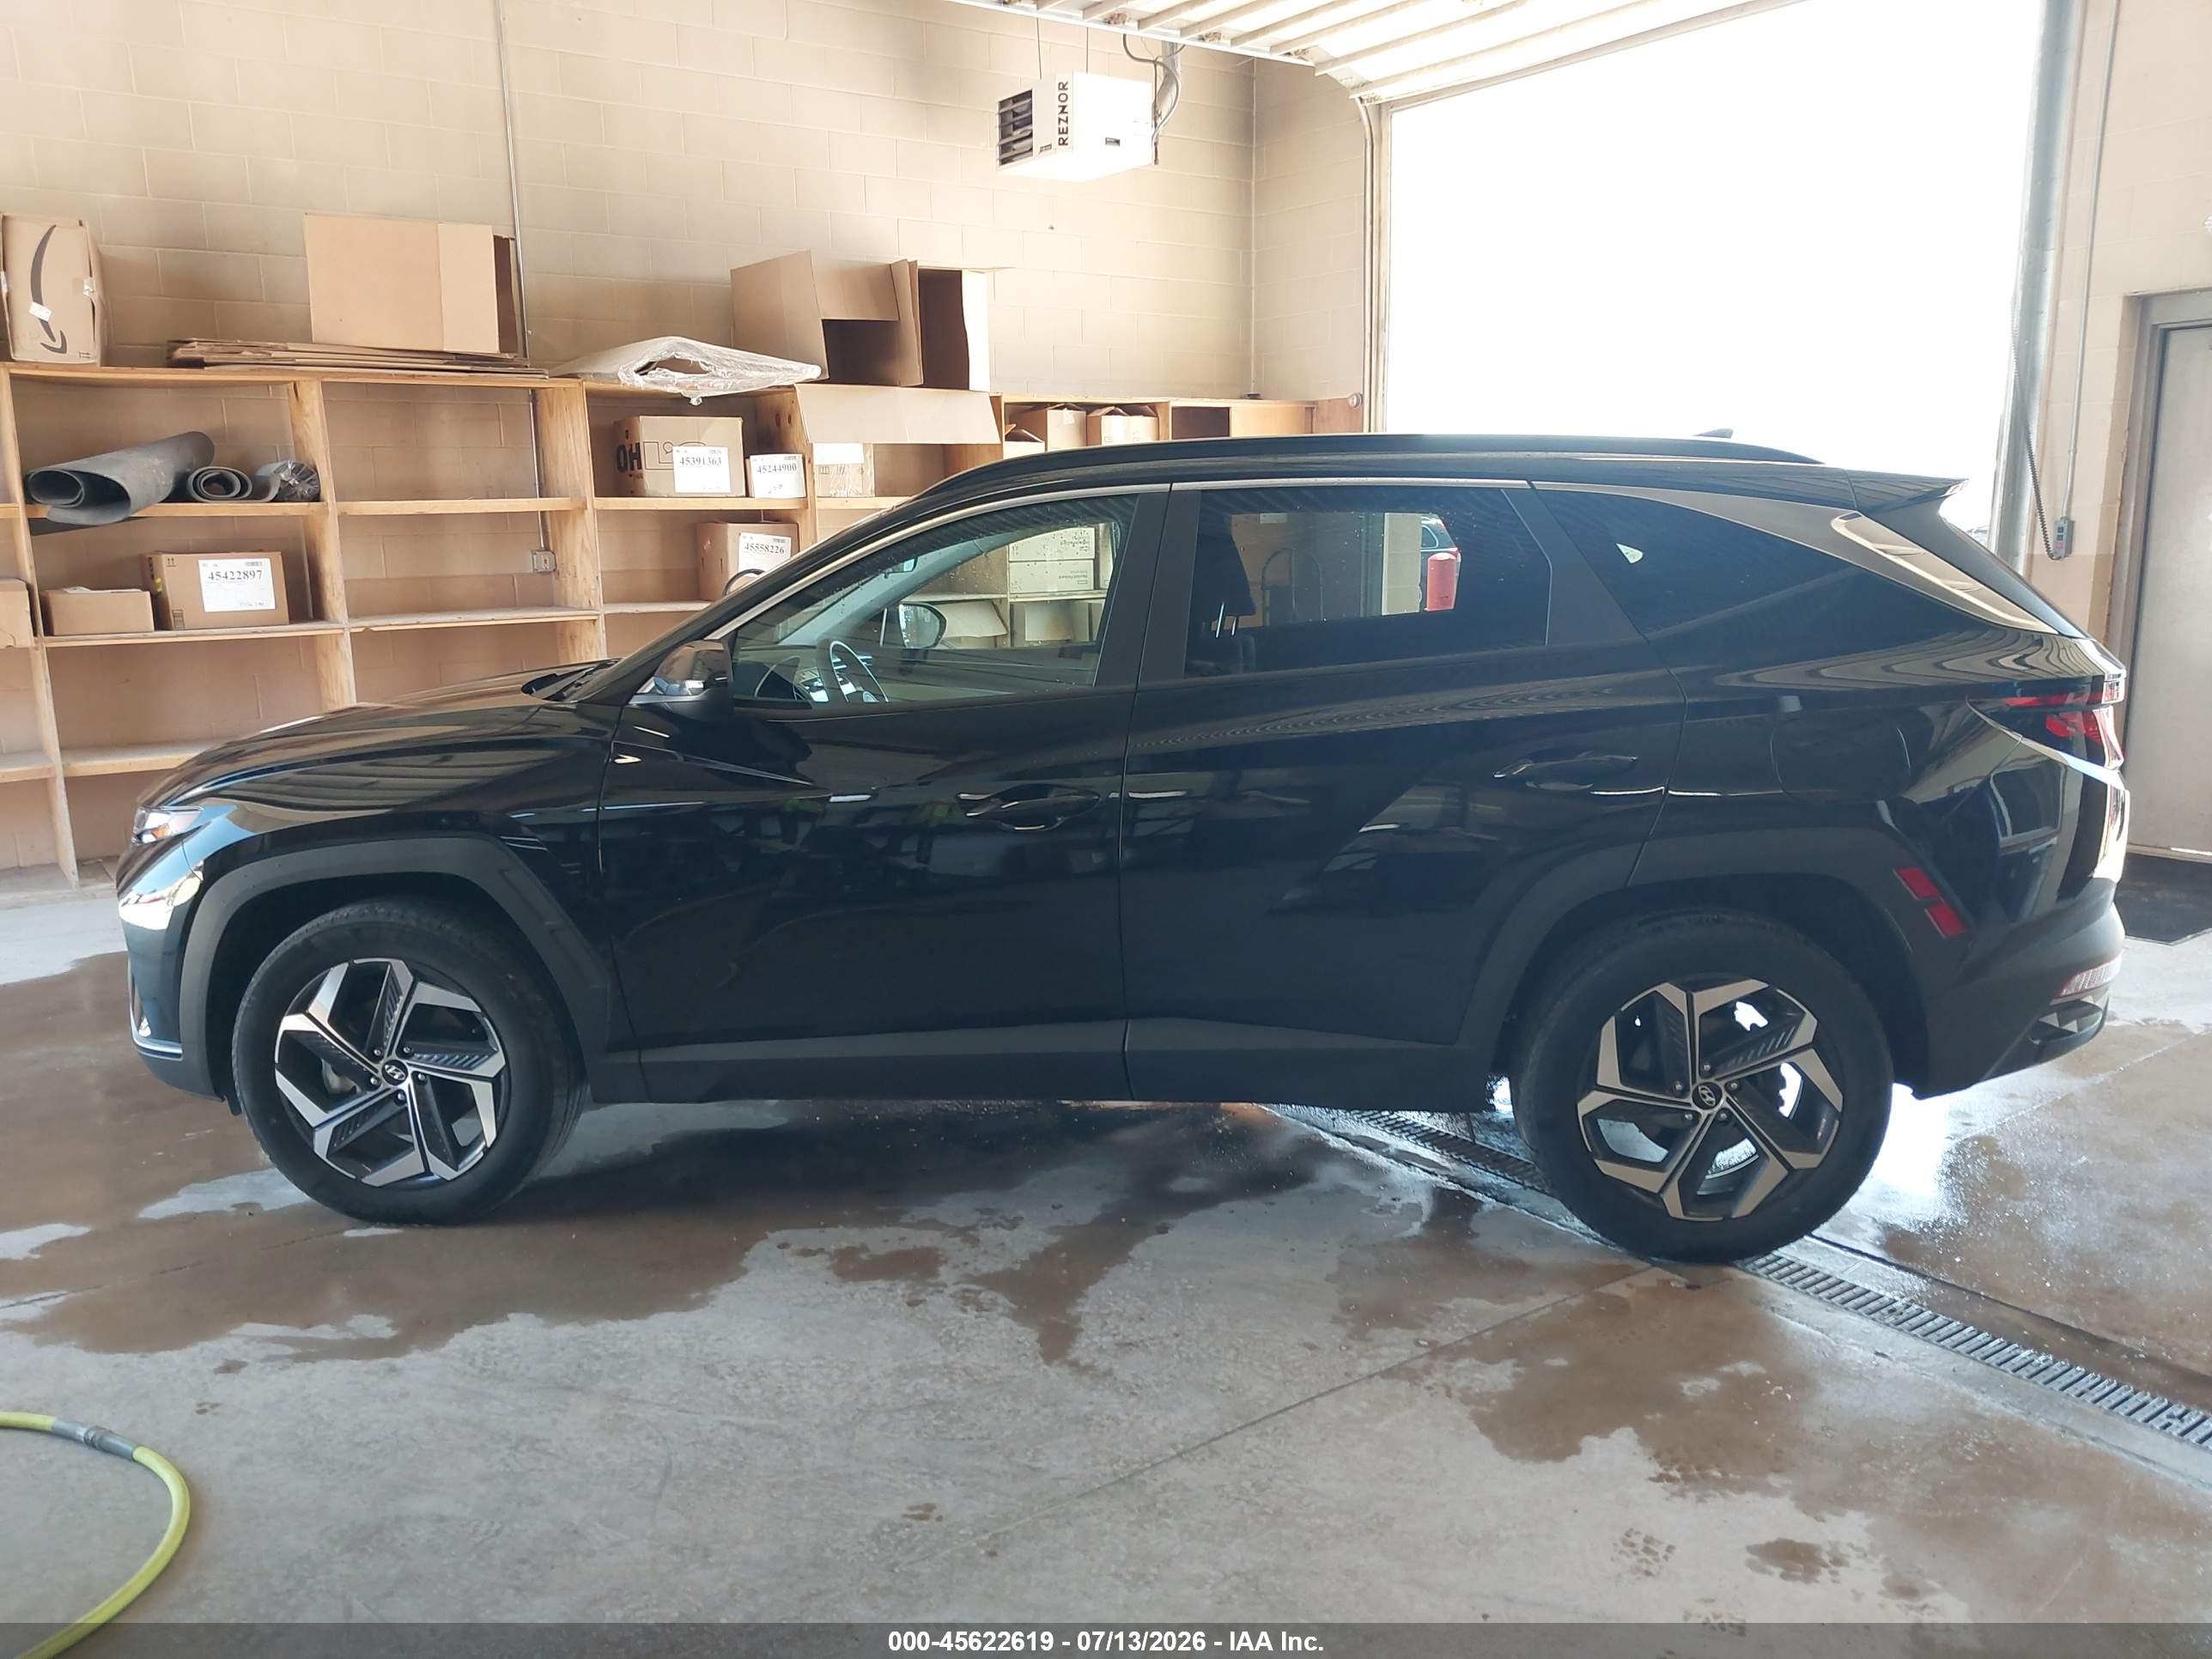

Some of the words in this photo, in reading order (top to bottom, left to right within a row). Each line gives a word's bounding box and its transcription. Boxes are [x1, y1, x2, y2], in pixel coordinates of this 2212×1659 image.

[1058, 81, 1069, 146] REZNOR
[744, 543, 785, 555] 45558226
[208, 569, 263, 580] 45422897
